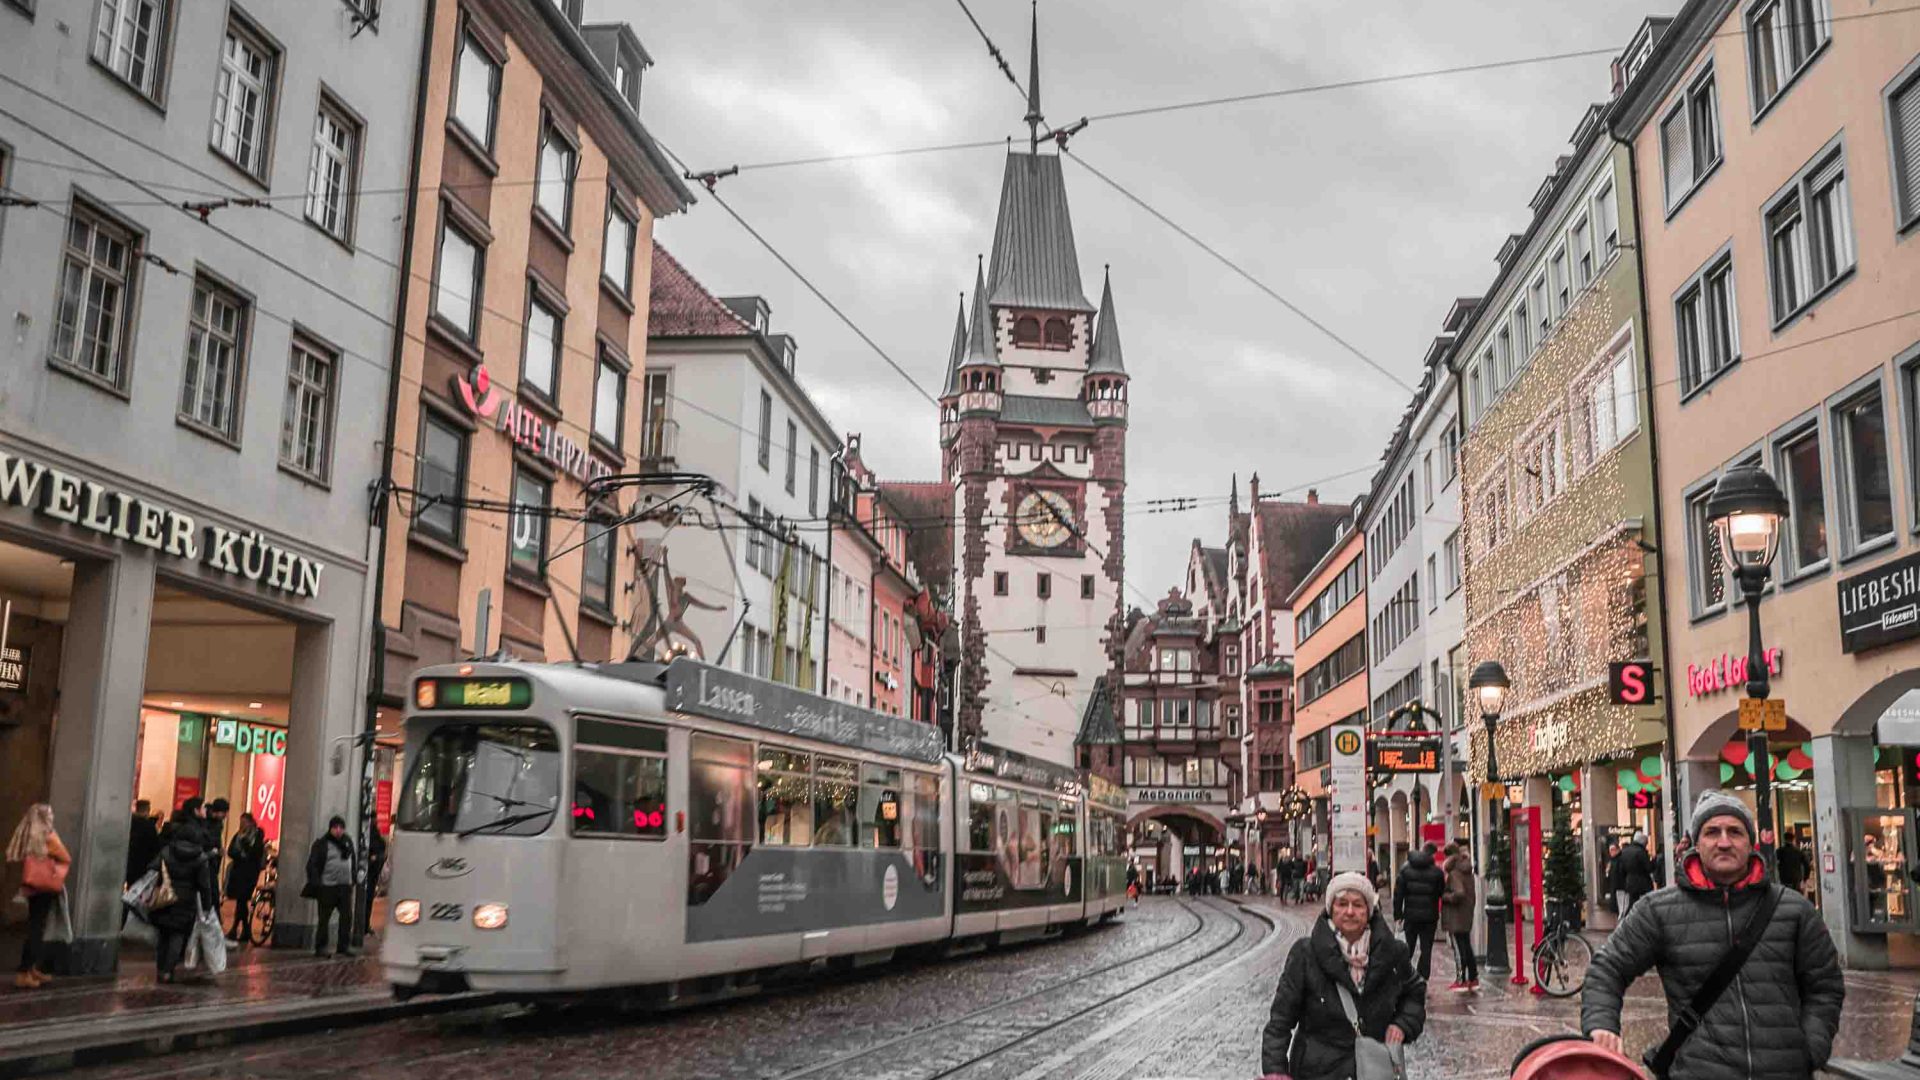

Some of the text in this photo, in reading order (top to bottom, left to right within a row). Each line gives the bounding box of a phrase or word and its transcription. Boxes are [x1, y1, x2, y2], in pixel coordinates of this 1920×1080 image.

[500, 399, 543, 453] ALTE
[0, 451, 325, 600] WELIER KÜHN
[1620, 664, 1646, 703] S
[1688, 658, 1721, 698] Foot
[236, 726, 288, 757] DEIC
[1138, 789, 1212, 801] McDonald's
[430, 902, 463, 921] 225
